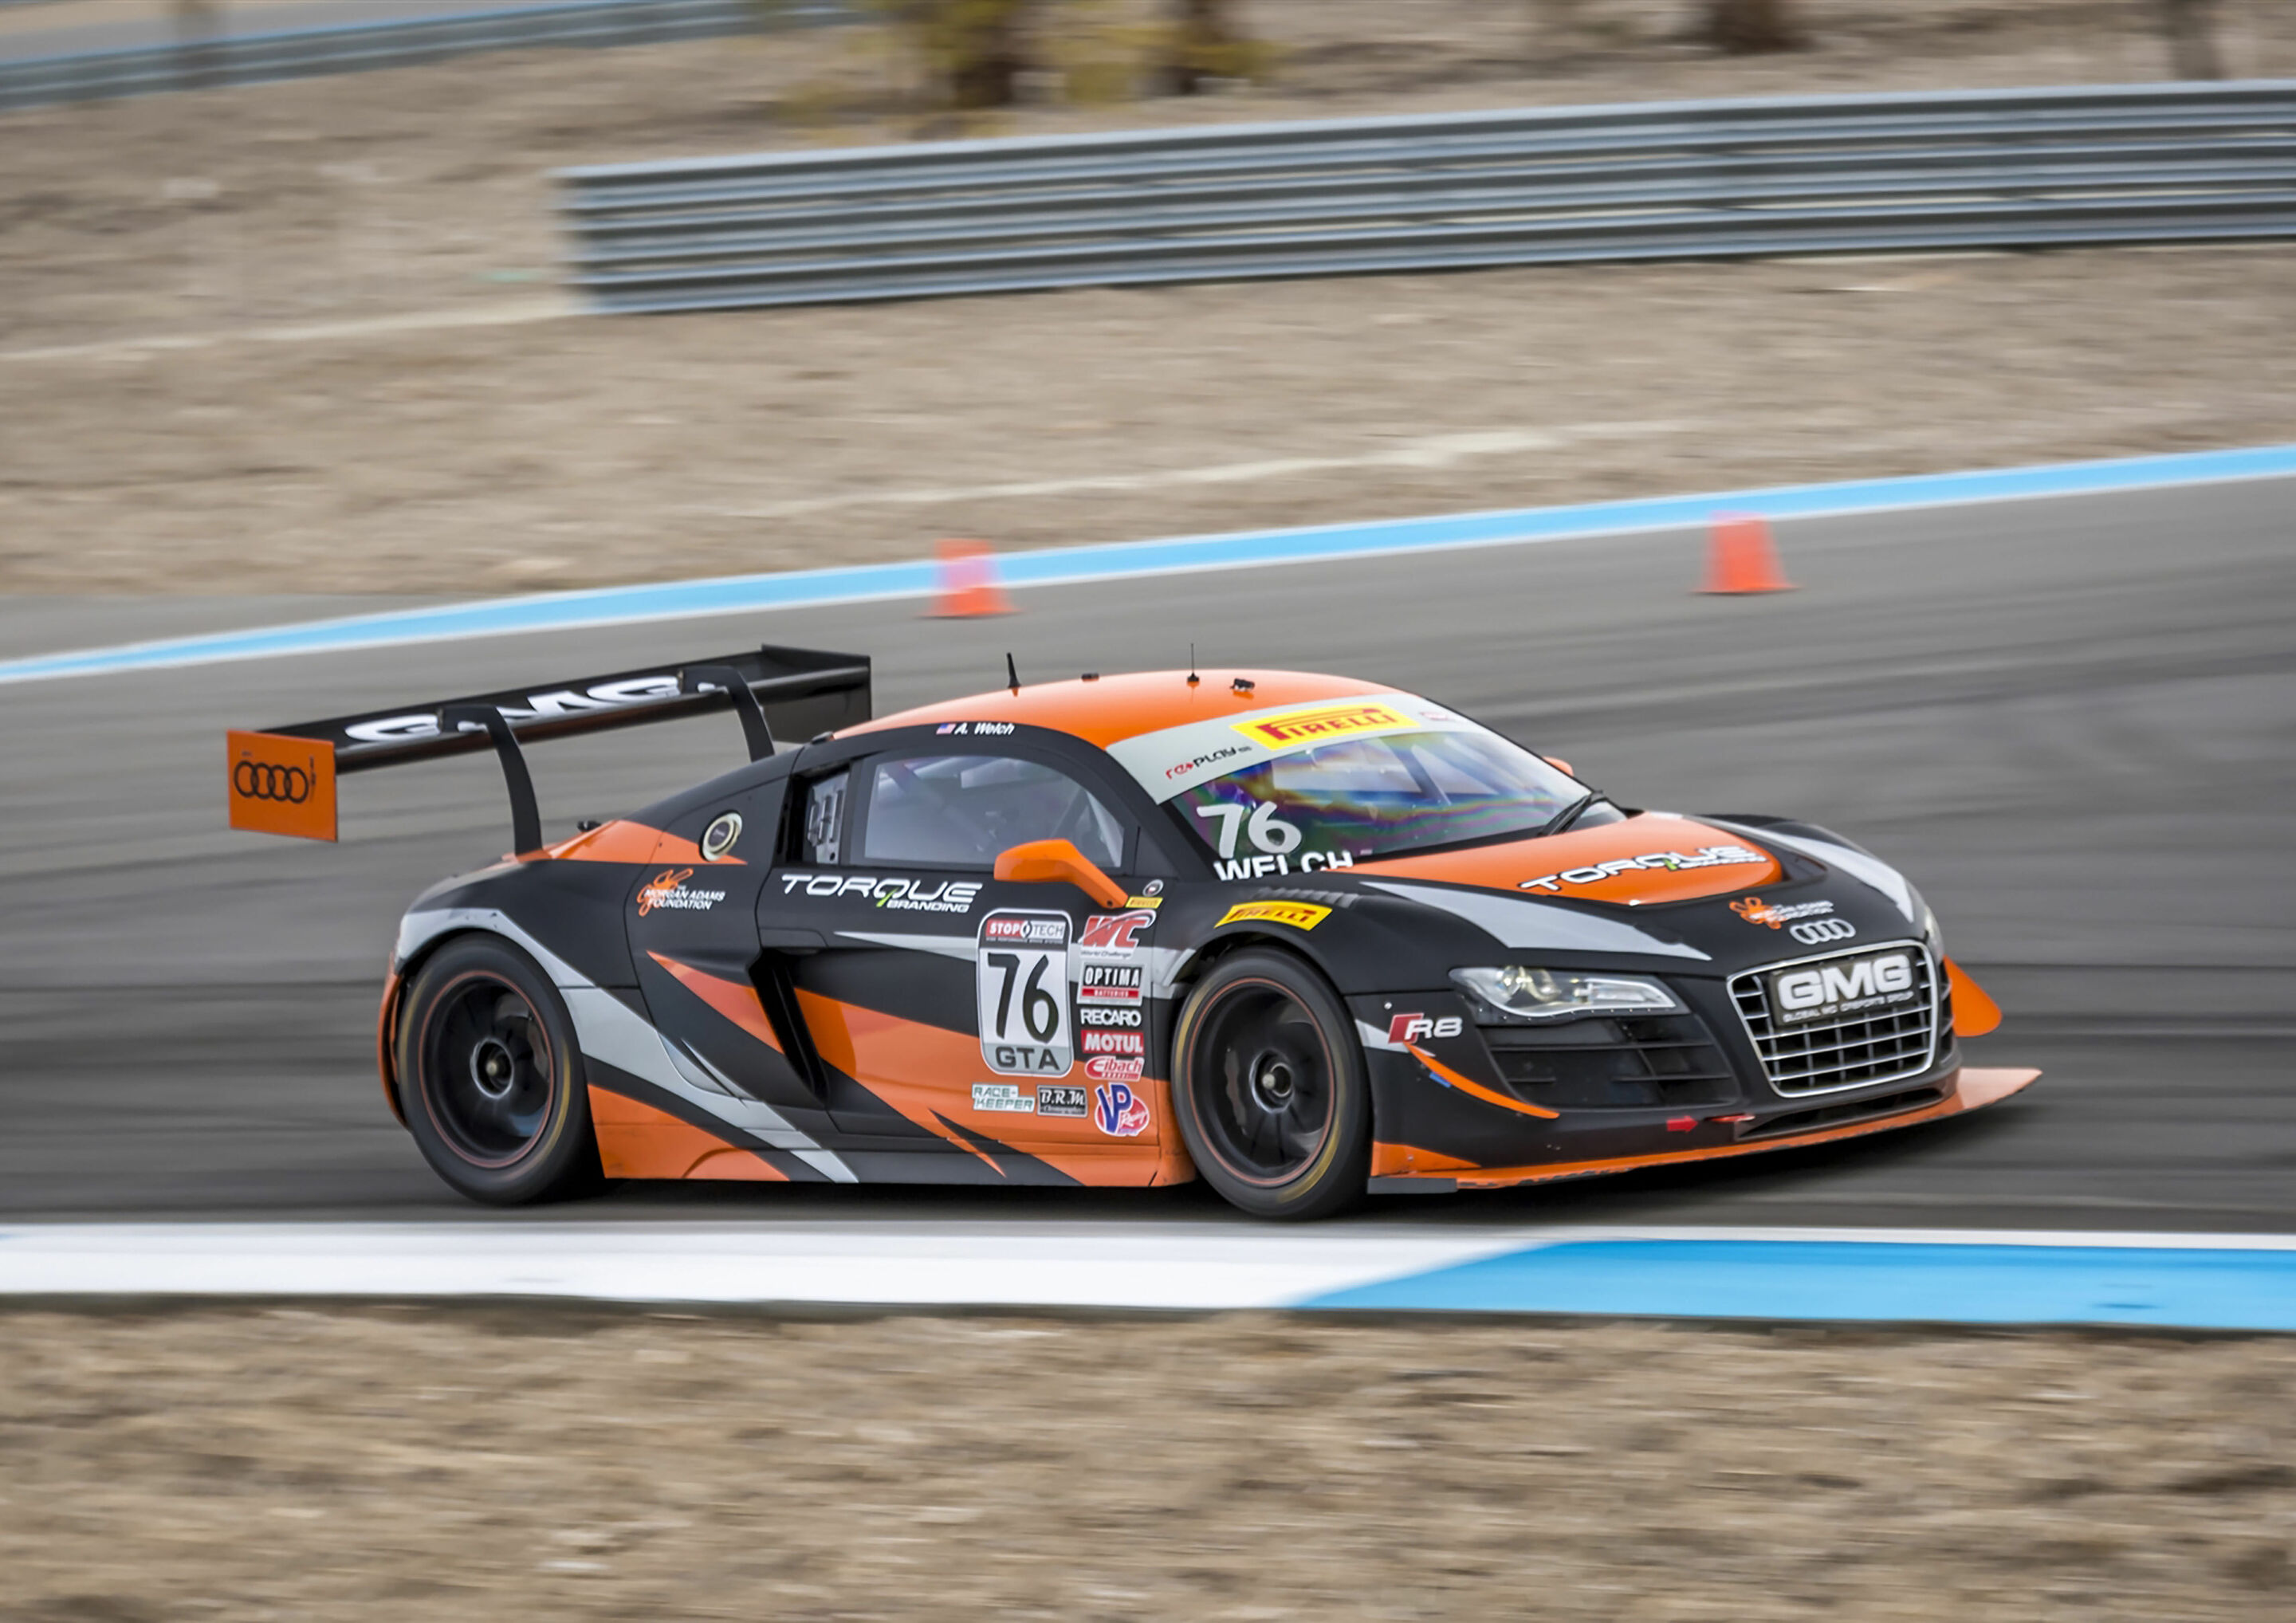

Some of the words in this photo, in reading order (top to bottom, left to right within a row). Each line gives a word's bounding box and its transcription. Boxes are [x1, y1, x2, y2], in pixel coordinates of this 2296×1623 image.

[954, 722, 968, 735] A.
[974, 722, 1015, 735] Welch
[1256, 709, 1398, 741] PIRELLI
[1197, 801, 1303, 859] 76
[1519, 845, 1758, 891] TORQUE
[644, 889, 688, 900] MORGAN
[688, 890, 725, 902] ADAMS
[782, 874, 983, 903] TORQUE
[647, 899, 713, 910] FOUNDATION
[887, 900, 970, 914] BRANDING
[1226, 909, 1316, 922] PIRELLI
[1083, 916, 1150, 948] WC
[1085, 966, 1140, 986] OPTIMA
[1778, 954, 1913, 1010] GMG
[988, 953, 1060, 1044] 76
[1080, 1008, 1142, 1027] RECARO
[1404, 1016, 1463, 1039] R8
[1084, 1032, 1143, 1053] MOTUL
[995, 1047, 1060, 1071] GTA
[1087, 1057, 1142, 1078] Eibach
[975, 1098, 1034, 1110] KEEPER
[1097, 1084, 1132, 1133] VP
